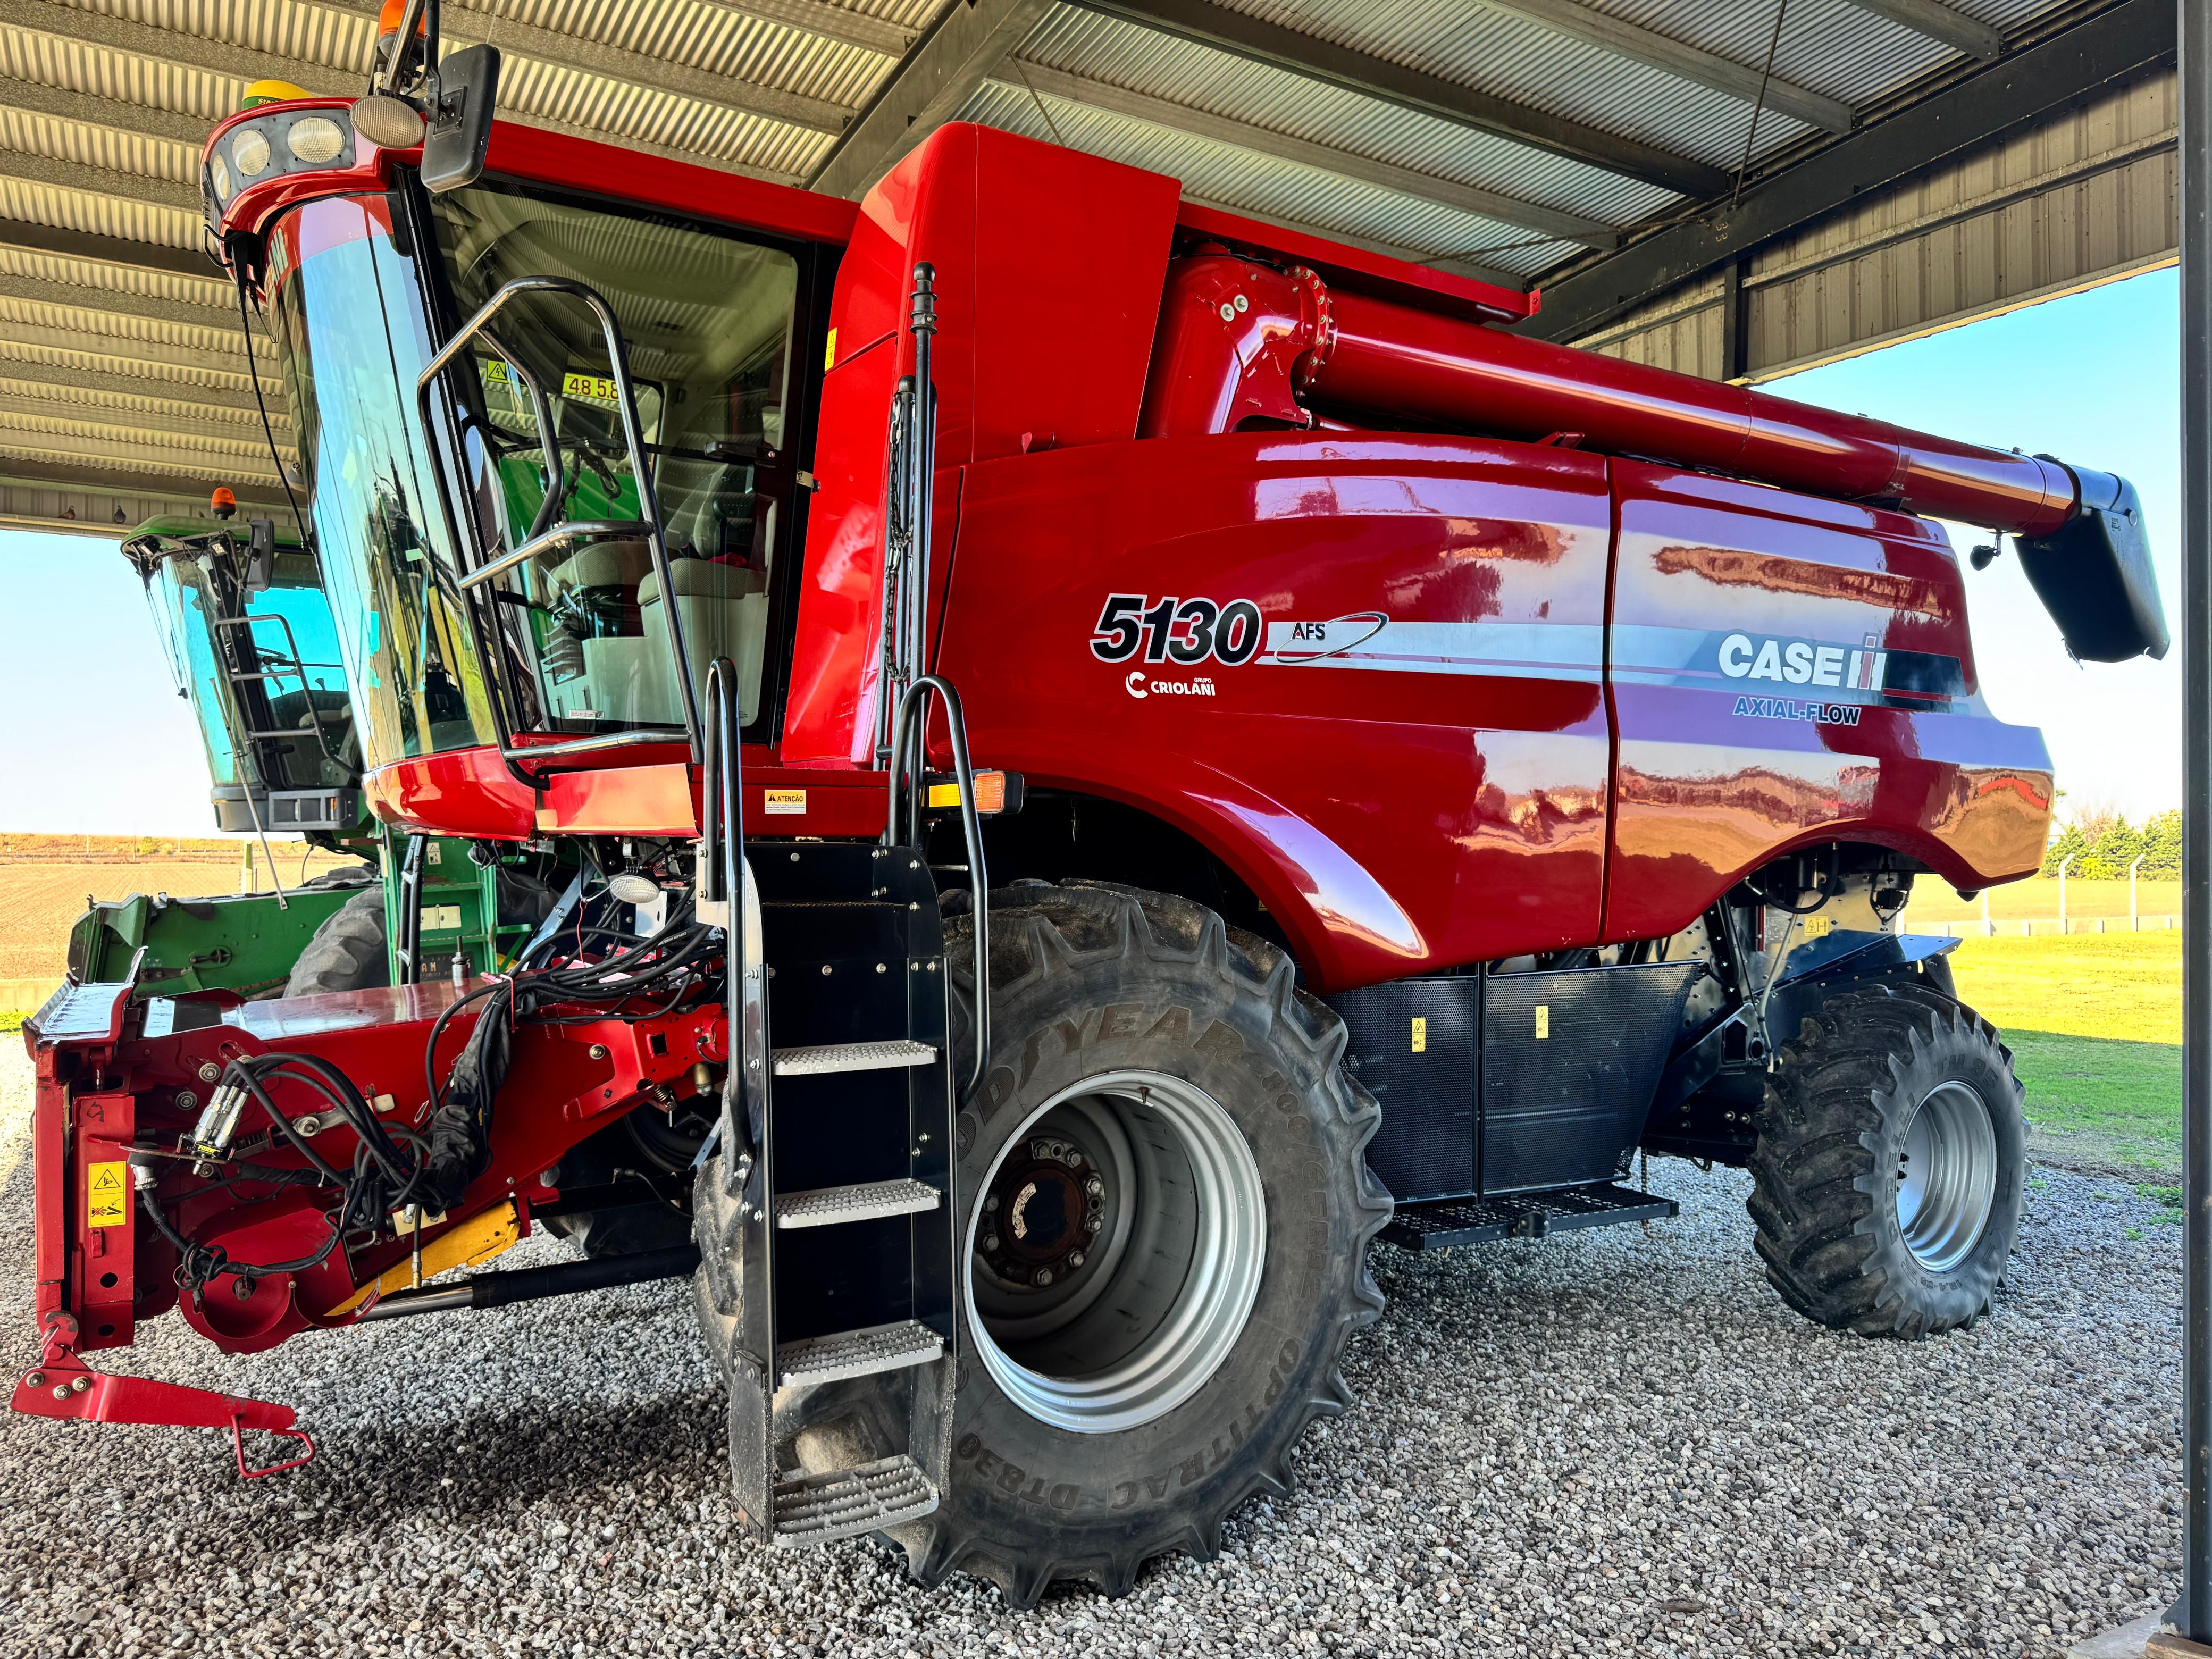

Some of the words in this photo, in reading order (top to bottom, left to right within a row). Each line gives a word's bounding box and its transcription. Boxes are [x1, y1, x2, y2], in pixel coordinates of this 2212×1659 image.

[569, 378, 591, 395] 4.8
[597, 379, 619, 399] 5.8
[1090, 593, 1262, 667] 5130
[1292, 622, 1326, 641] AFS
[1151, 681, 1216, 696] CRIOLANI
[1732, 696, 1861, 726] AXIAL-FLOW
[777, 794, 803, 803] ATENÇÃO
[1971, 1057, 1999, 1089] 95
[1886, 1092, 1915, 1245] PIRELLI
[1110, 1338, 1300, 1510] OPTITRAC
[957, 1432, 1082, 1511] DT830
